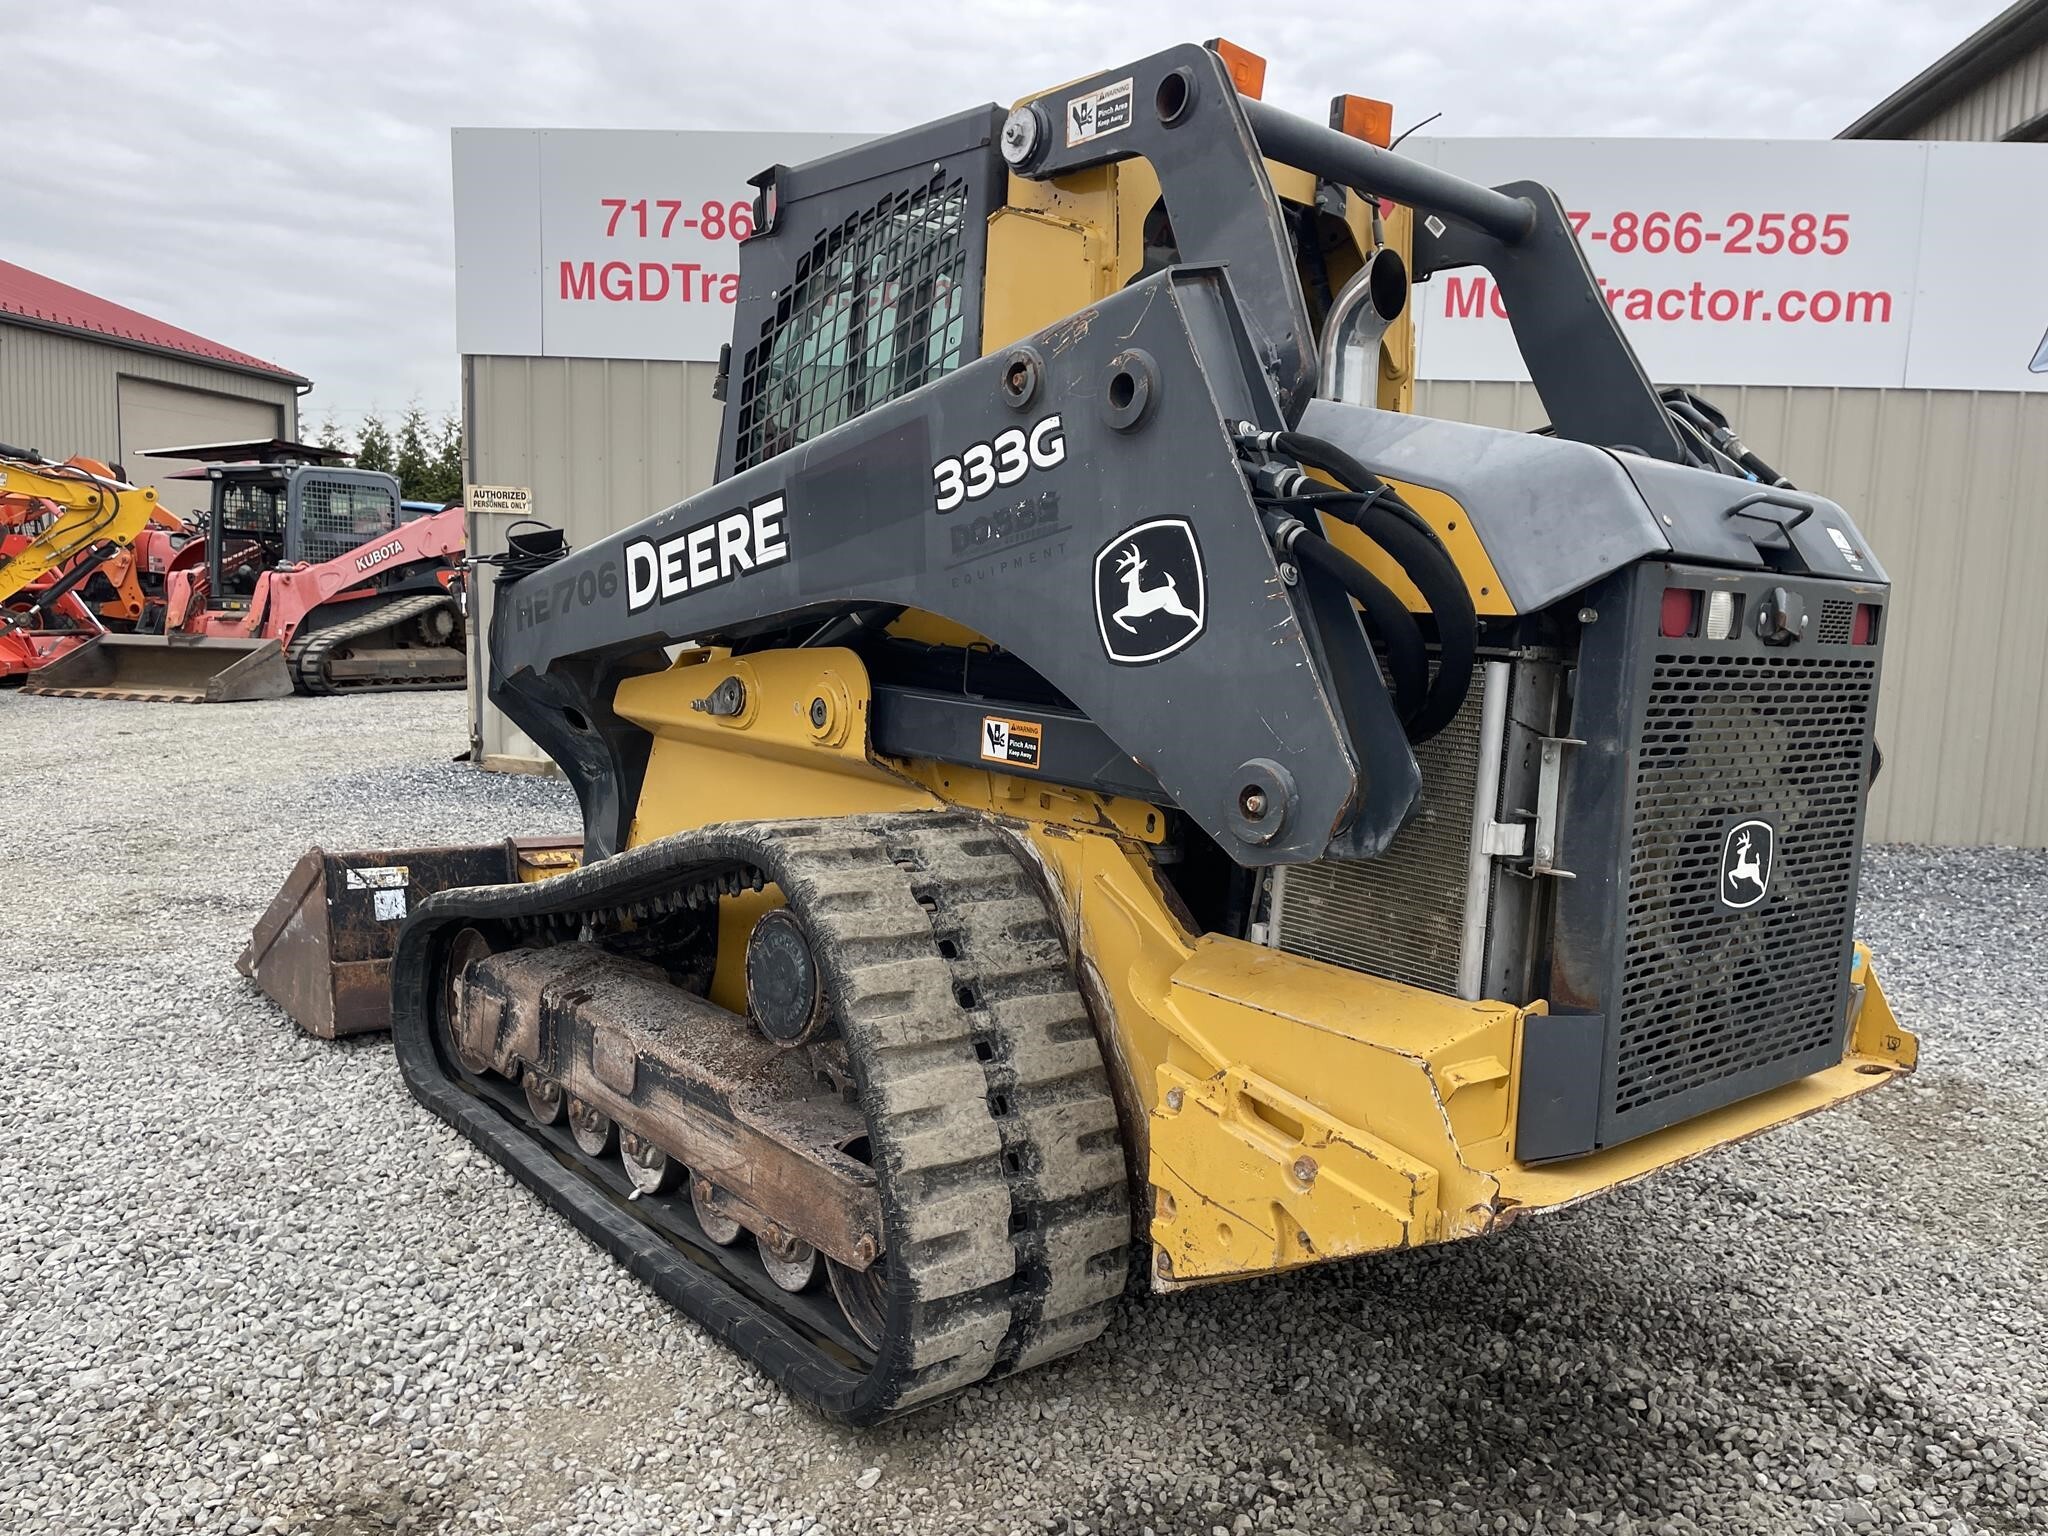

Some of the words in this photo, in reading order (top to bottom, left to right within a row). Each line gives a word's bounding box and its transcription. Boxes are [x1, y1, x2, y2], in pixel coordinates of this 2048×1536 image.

[1105, 83, 1130, 98] WARNING
[1098, 106, 1114, 118] Pinch
[1114, 102, 1128, 112] Area
[1097, 119, 1110, 127] Keep
[1110, 114, 1124, 122] Away
[933, 414, 1066, 512] 333G
[473, 490, 527, 500] AUTHORIZED
[473, 500, 509, 509] PERSONNEL
[510, 502, 527, 510] ONLY
[355, 540, 404, 571] KUBOTA
[625, 493, 788, 612] DEERE
[951, 542, 1066, 589] EQUIPMENT
[1016, 725, 1039, 735] WARNING
[1009, 739, 1023, 748] Pinch
[1024, 742, 1037, 751] Area
[1008, 749, 1020, 758] Keep
[1020, 751, 1032, 760] Away
